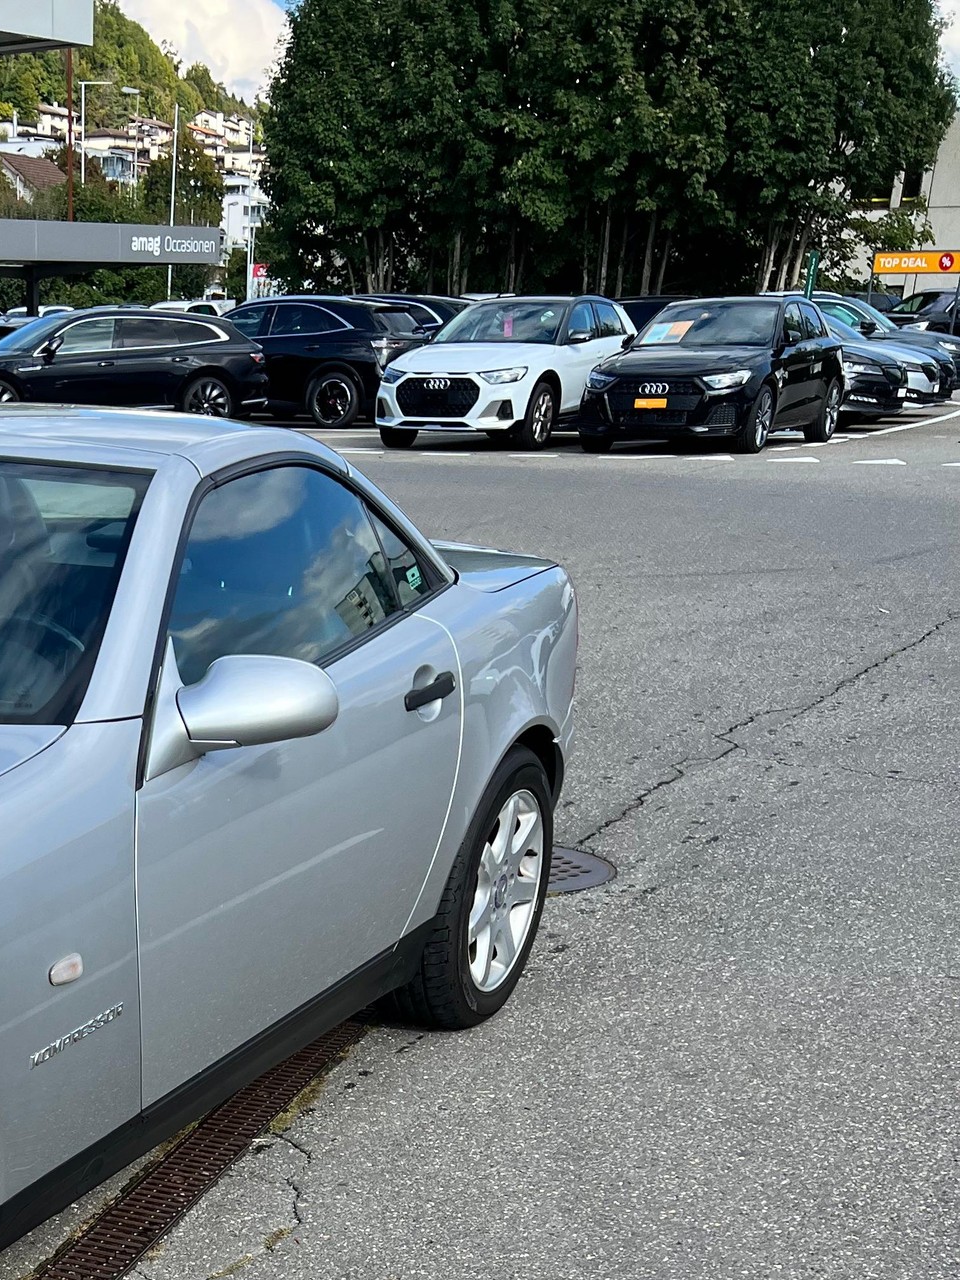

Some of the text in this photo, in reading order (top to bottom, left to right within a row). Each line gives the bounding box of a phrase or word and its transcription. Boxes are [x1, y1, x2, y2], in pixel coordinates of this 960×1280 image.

[131, 235, 216, 256] amag Occasionen
[880, 257, 900, 268] TOP
[901, 257, 928, 268] DEAL
[29, 1001, 124, 1070] KOMPRESSOR
